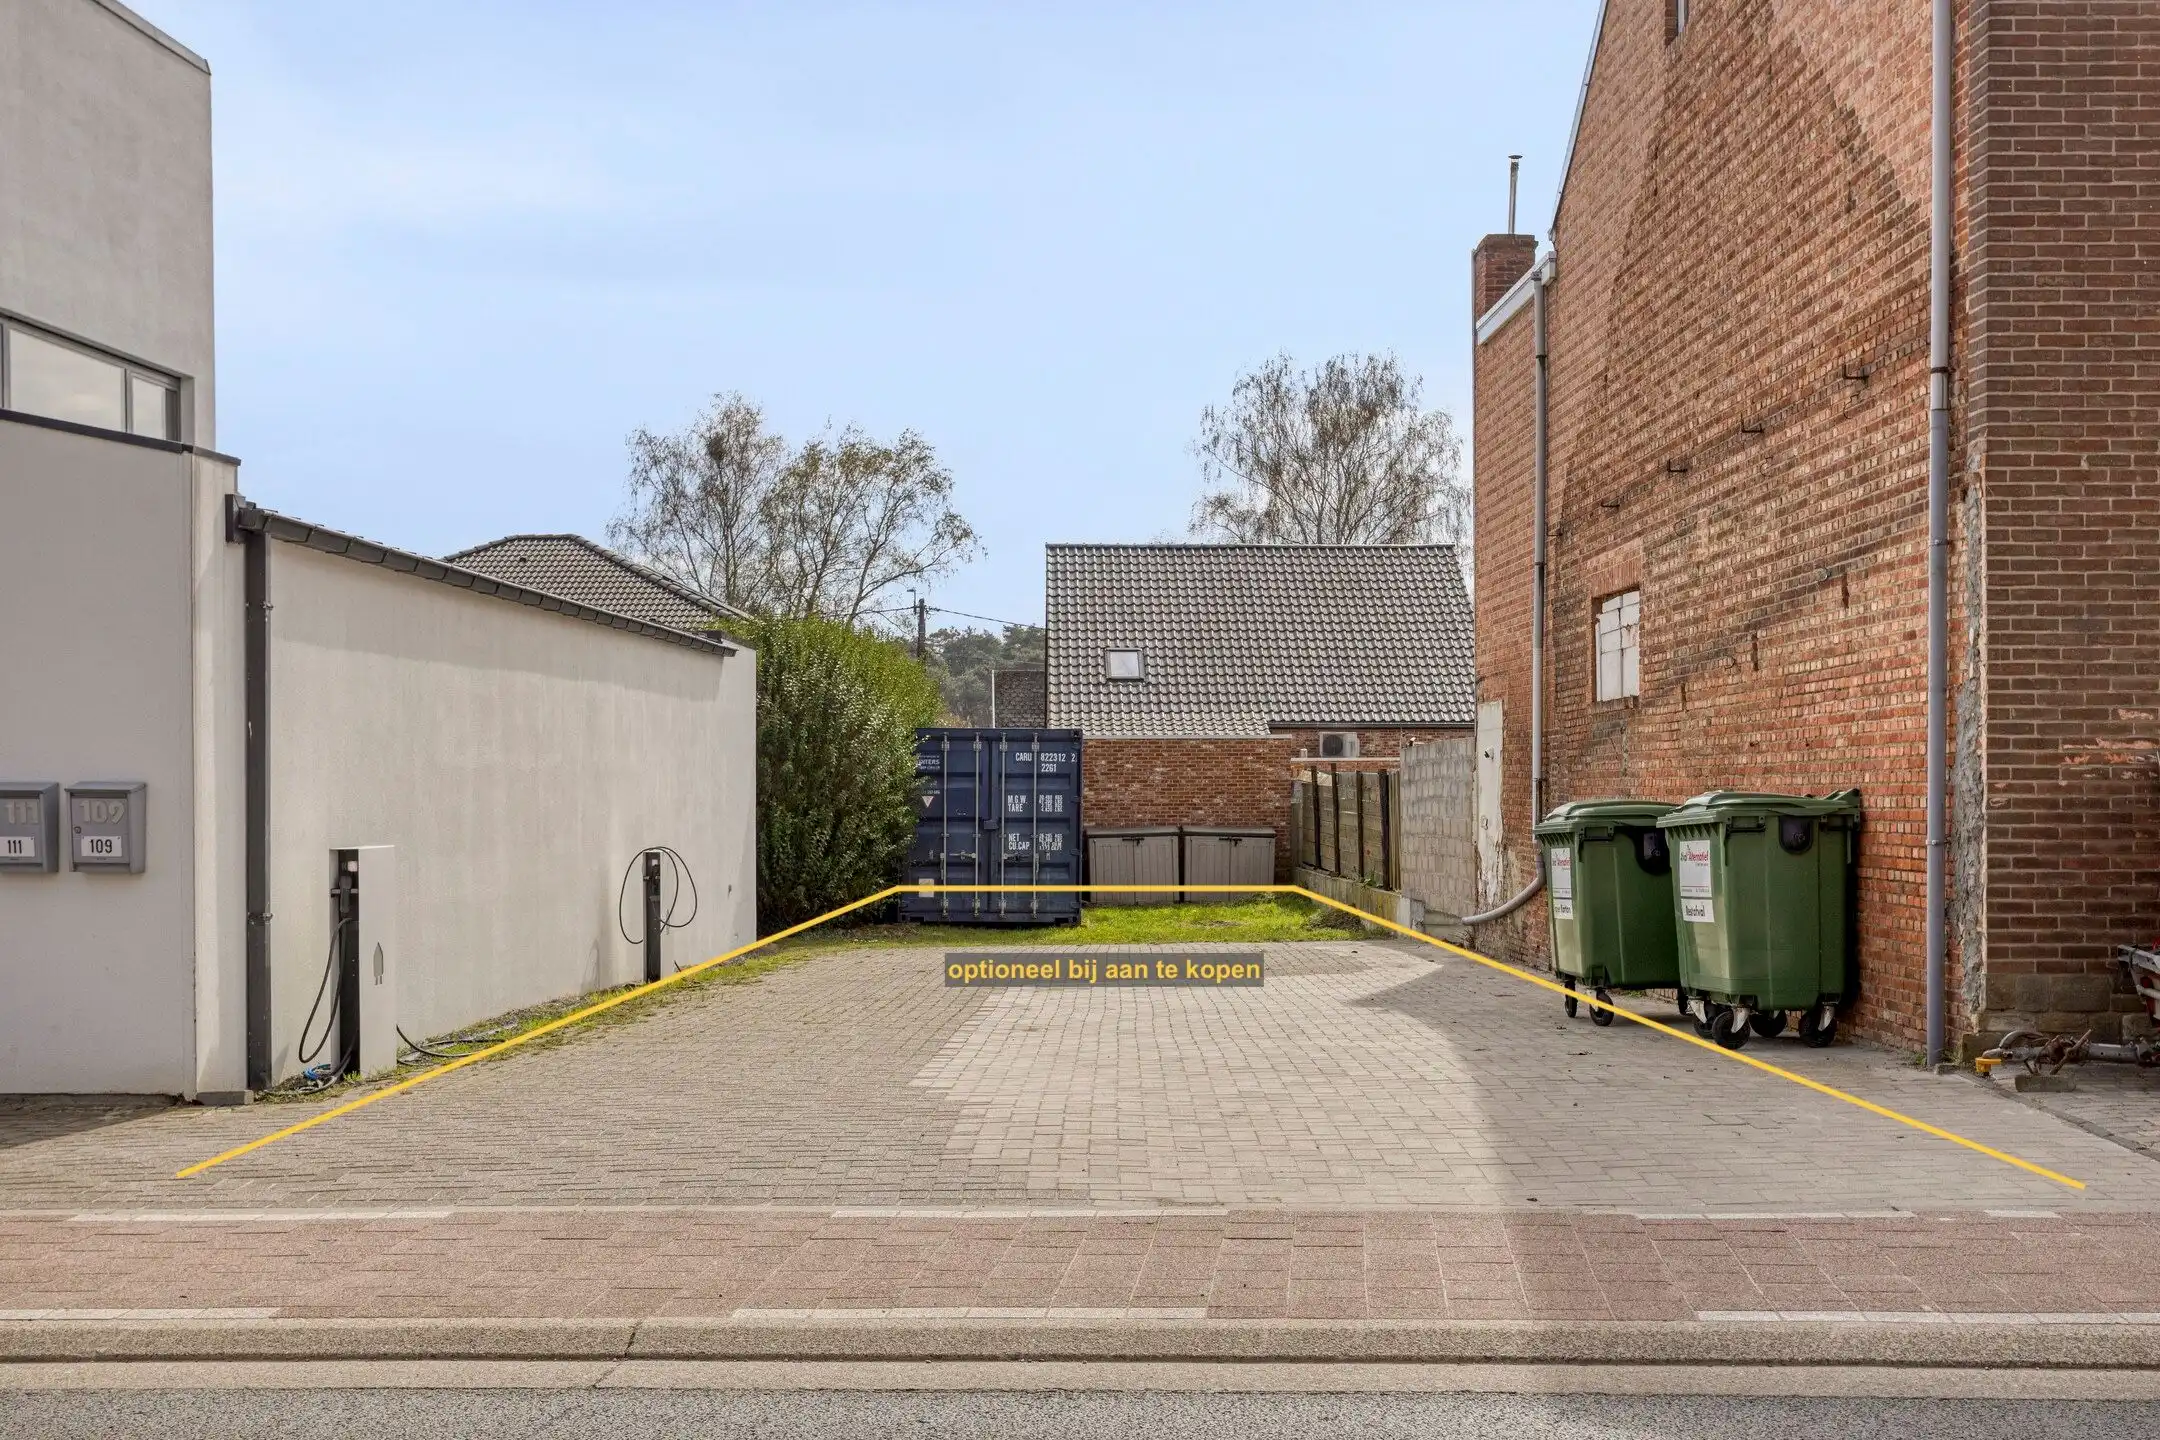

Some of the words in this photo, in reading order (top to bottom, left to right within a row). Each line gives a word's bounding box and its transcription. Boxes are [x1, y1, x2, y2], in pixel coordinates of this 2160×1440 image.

[1015, 752, 1032, 762] CARU
[1040, 752, 1066, 762] 822312
[5, 799, 39, 825] 111
[80, 799, 124, 825] 109
[1007, 803, 1023, 813] TARE
[1008, 833, 1020, 842] NET
[7, 839, 23, 854] 111
[89, 839, 113, 854] 109
